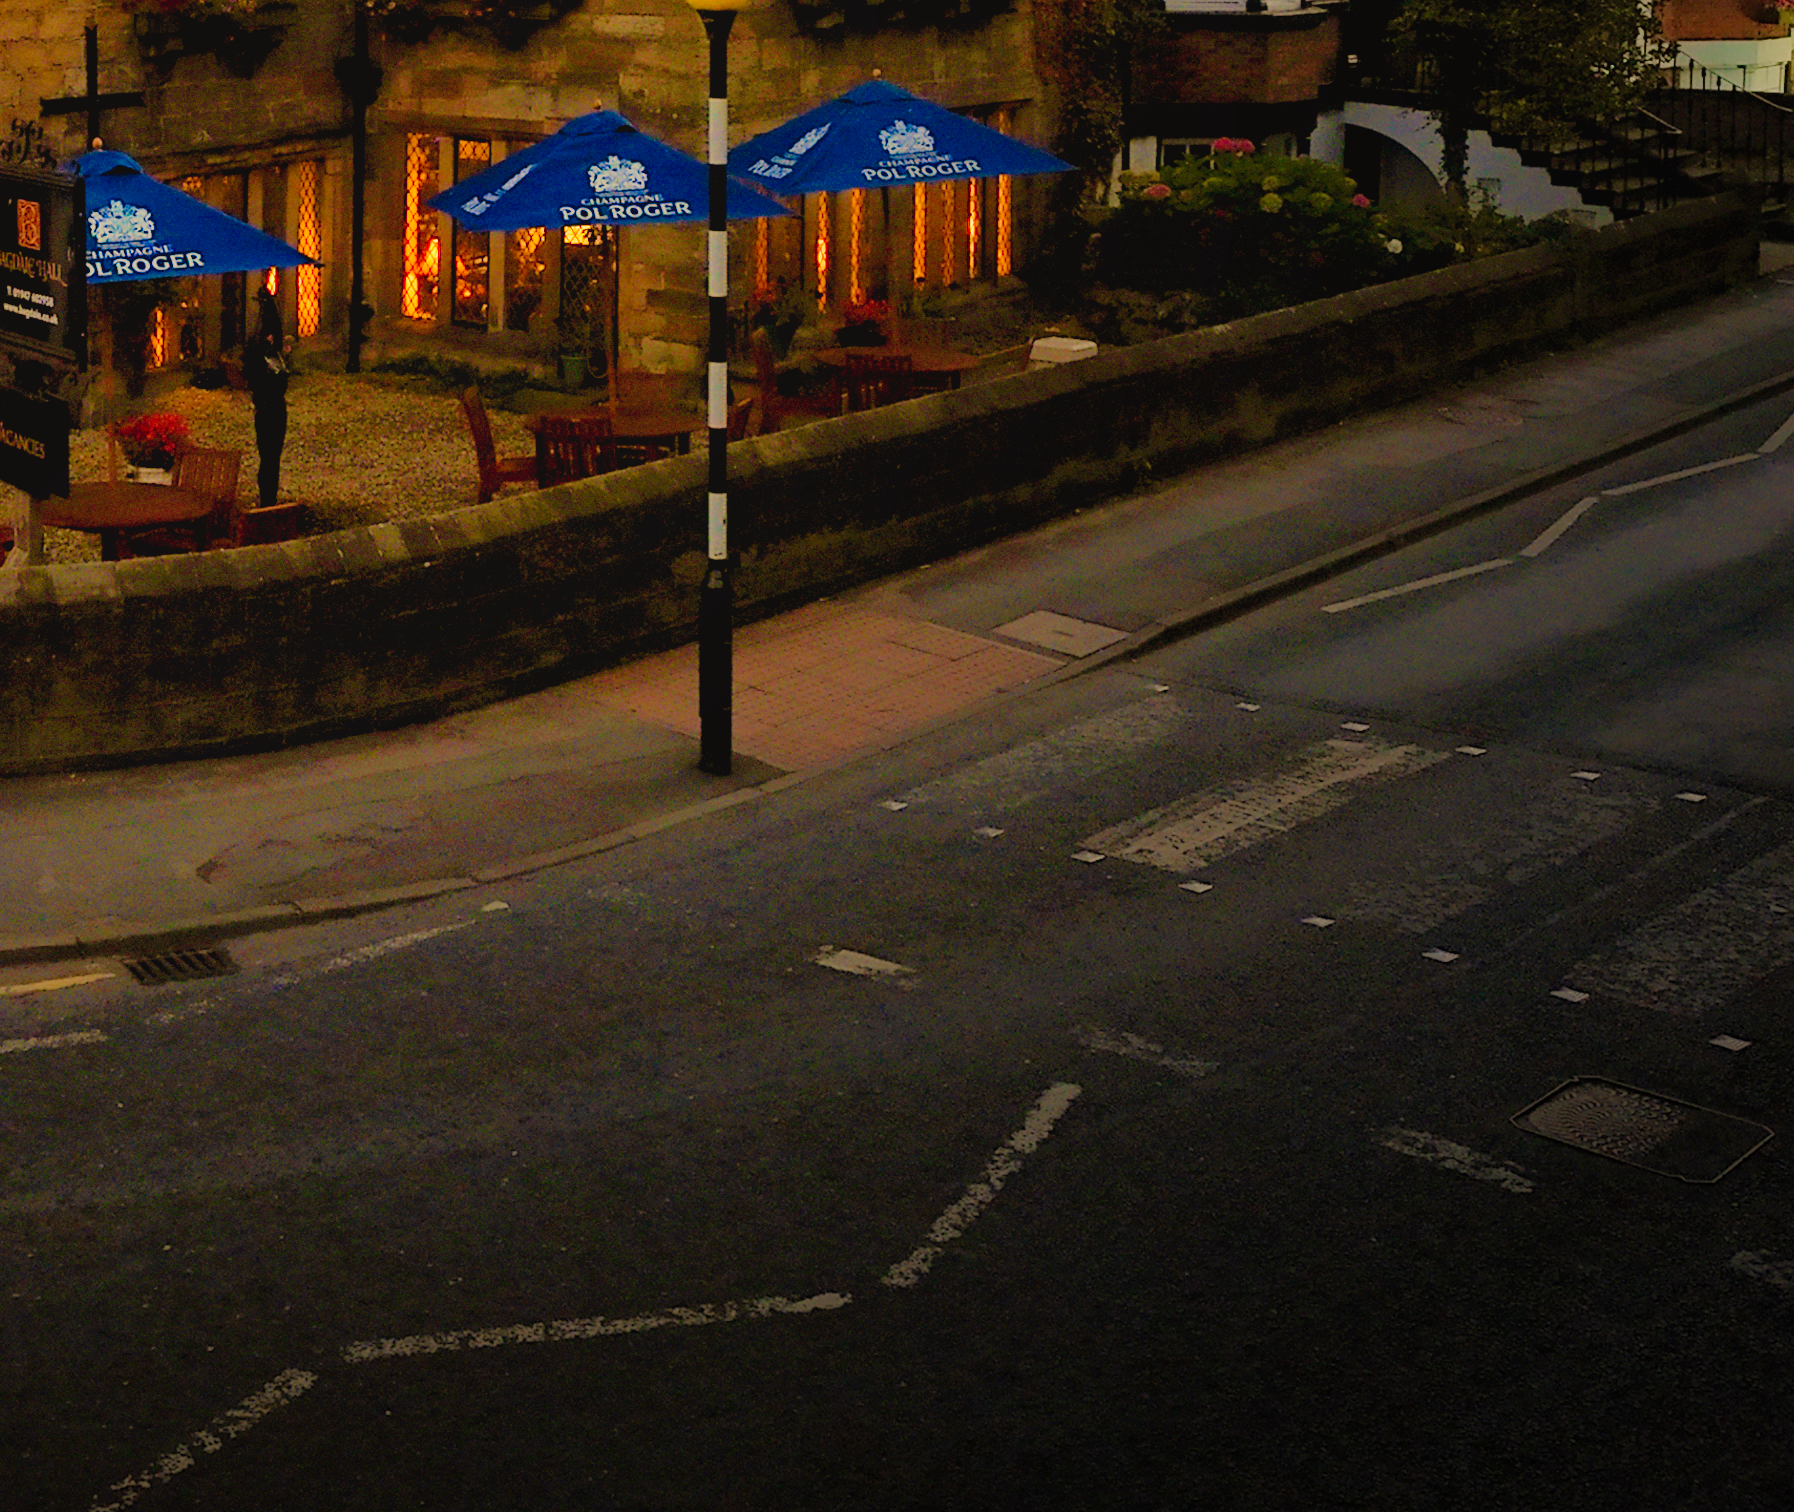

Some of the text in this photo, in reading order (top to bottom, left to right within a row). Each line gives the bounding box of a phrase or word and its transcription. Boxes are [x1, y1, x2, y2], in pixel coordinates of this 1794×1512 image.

[861, 159, 981, 180] POL ROGER
[879, 154, 953, 167] CHAMPAGNE
[581, 193, 664, 206] CHAMPAGNE
[560, 201, 692, 221] POL ROGER
[112, 252, 205, 275] ROGER
